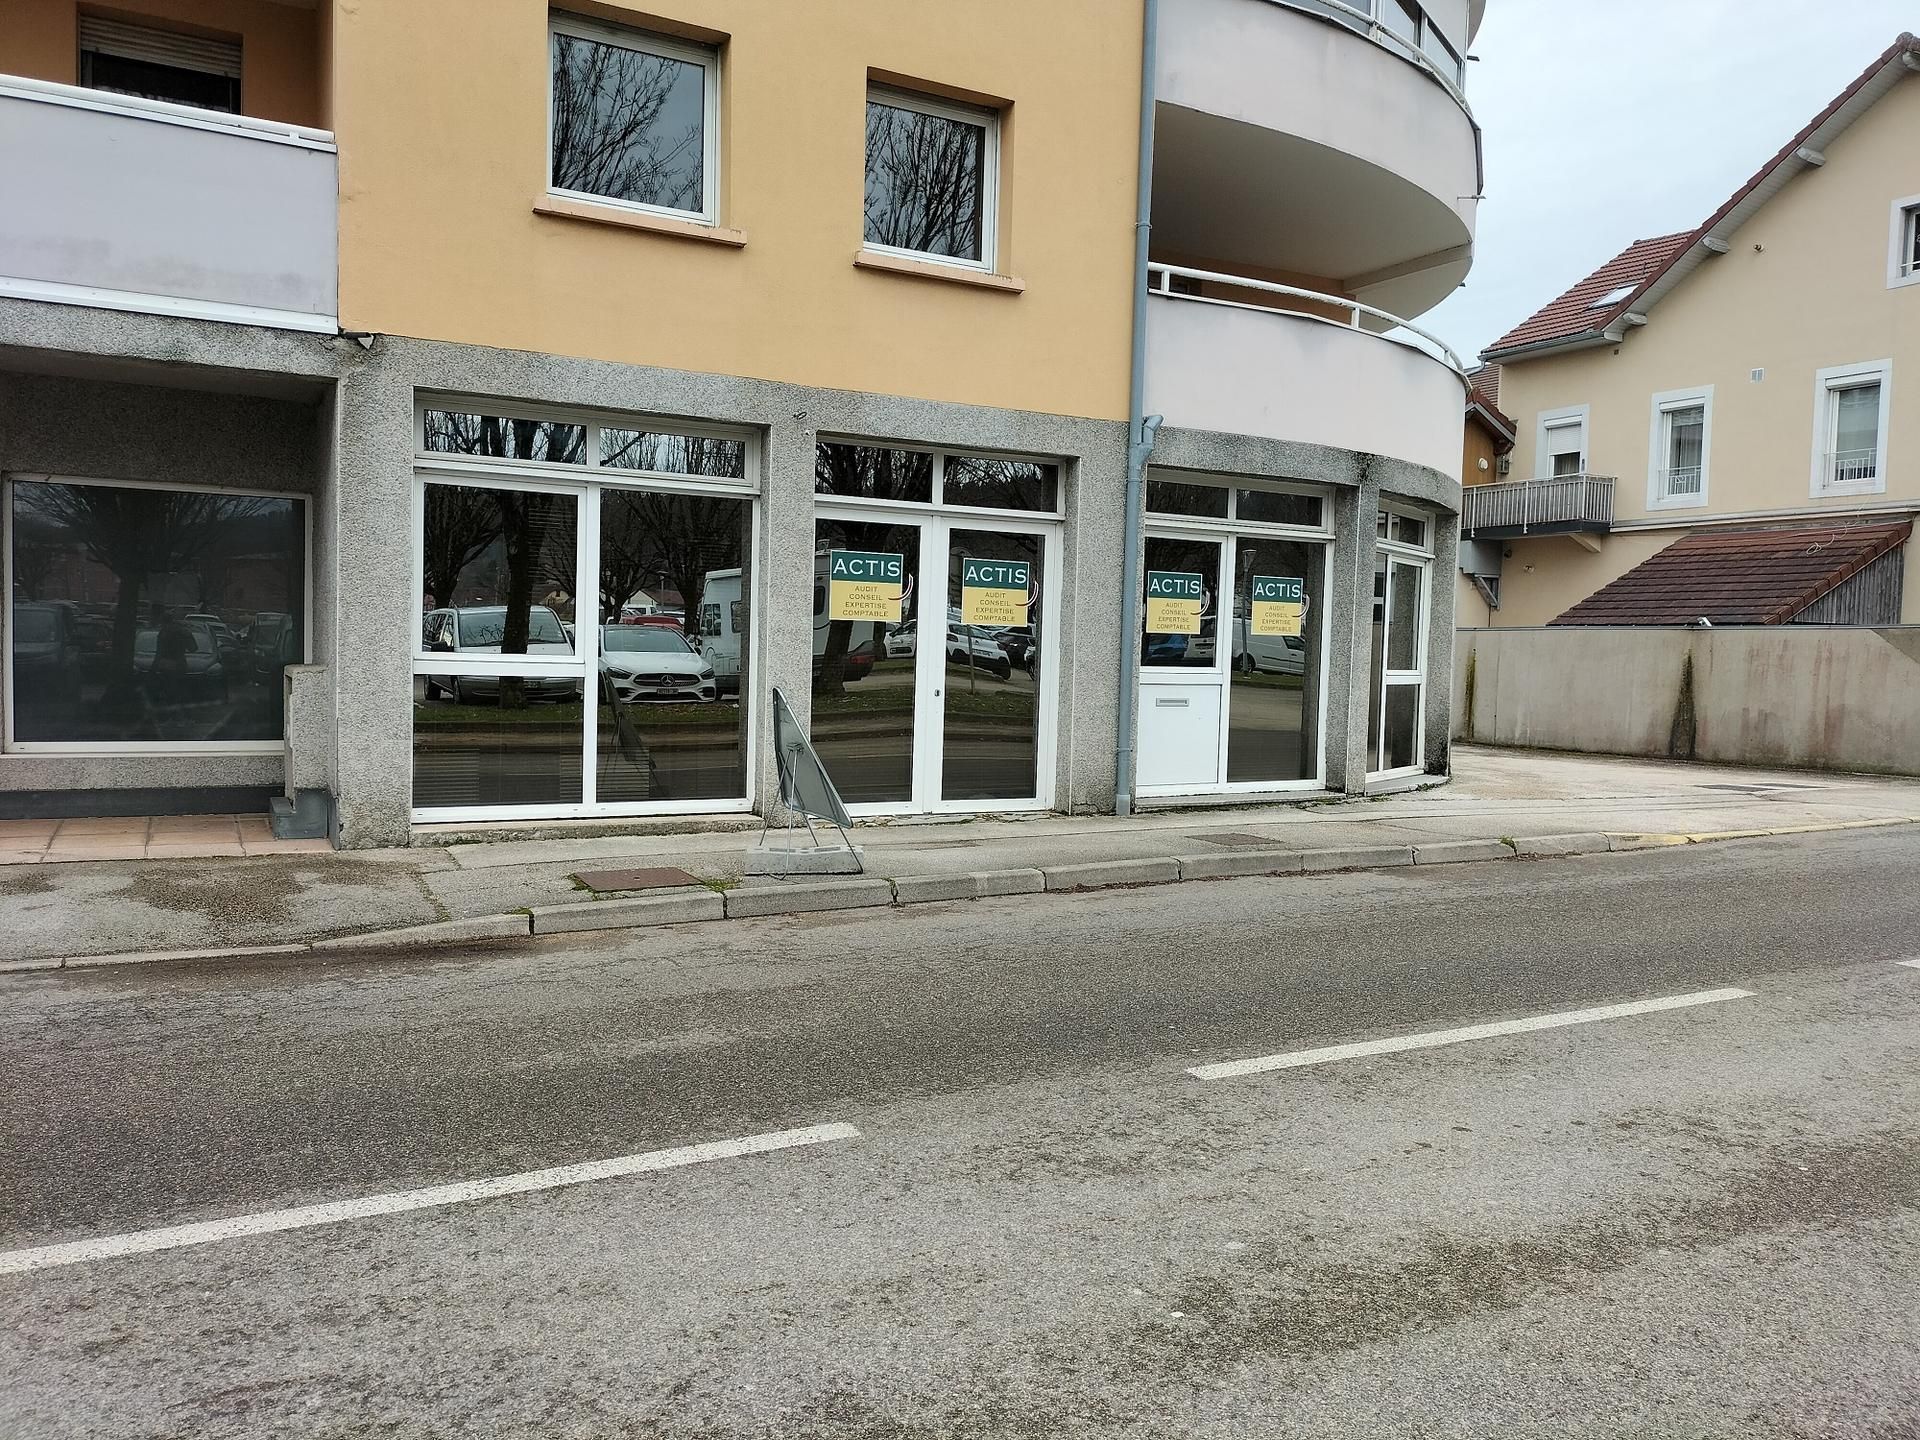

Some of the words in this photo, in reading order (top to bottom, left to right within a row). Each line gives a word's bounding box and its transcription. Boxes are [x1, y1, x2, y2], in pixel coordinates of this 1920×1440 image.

[832, 558, 901, 577] ACTIS
[965, 565, 1027, 584] ACTIS
[1149, 578, 1200, 594] ACTIS
[1254, 582, 1301, 598] ACTIS
[849, 593, 883, 601] CONSEIL
[845, 601, 887, 609] EXPERTISE
[979, 599, 1011, 607] CONSEIL
[842, 609, 889, 617] COMPTABLE
[973, 614, 1016, 622] COMPTABLE
